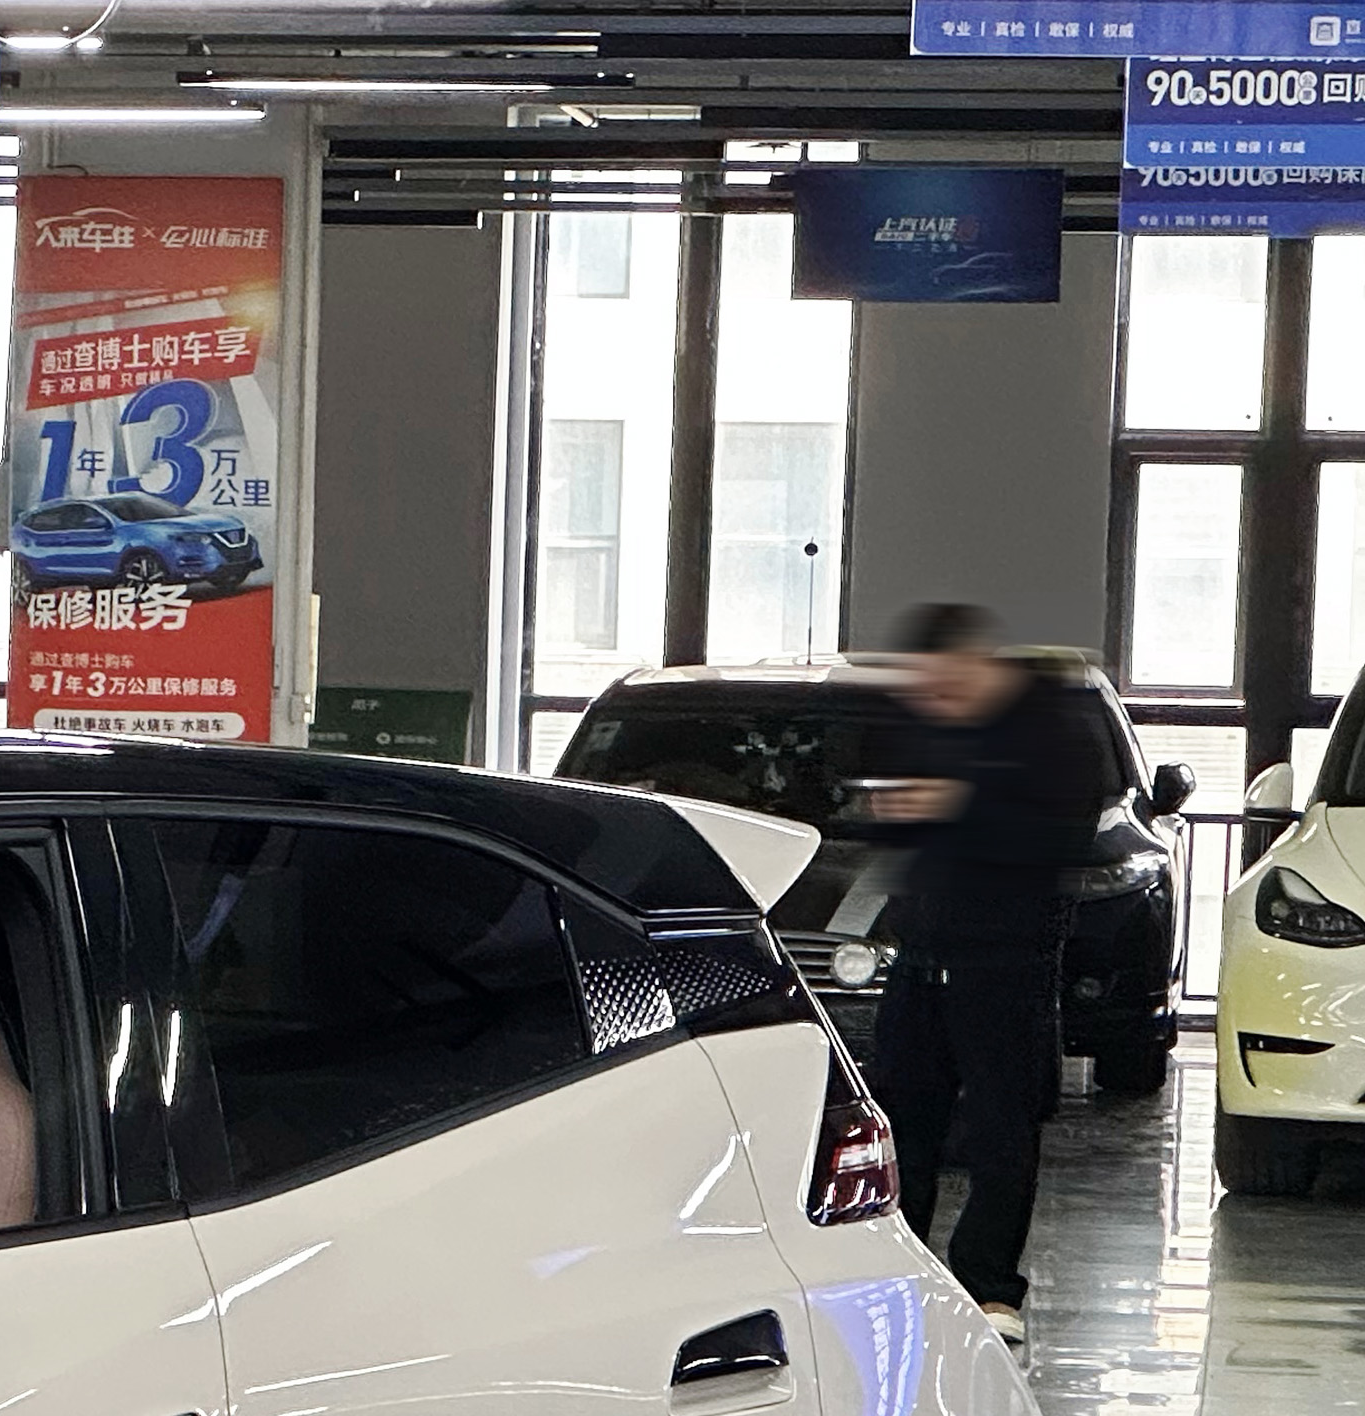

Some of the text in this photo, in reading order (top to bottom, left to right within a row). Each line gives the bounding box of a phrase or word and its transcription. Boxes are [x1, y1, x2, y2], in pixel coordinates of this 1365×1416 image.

[941, 21, 971, 36] 专业
[41, 326, 251, 375] 通过查博士购车享
[39, 375, 112, 396] 车况透明
[27, 583, 192, 630] 保修服务
[29, 652, 134, 669] 通过查博士购车
[29, 670, 236, 697] 享1年3万公里保修服务
[54, 716, 125, 730] 杜绝事故车
